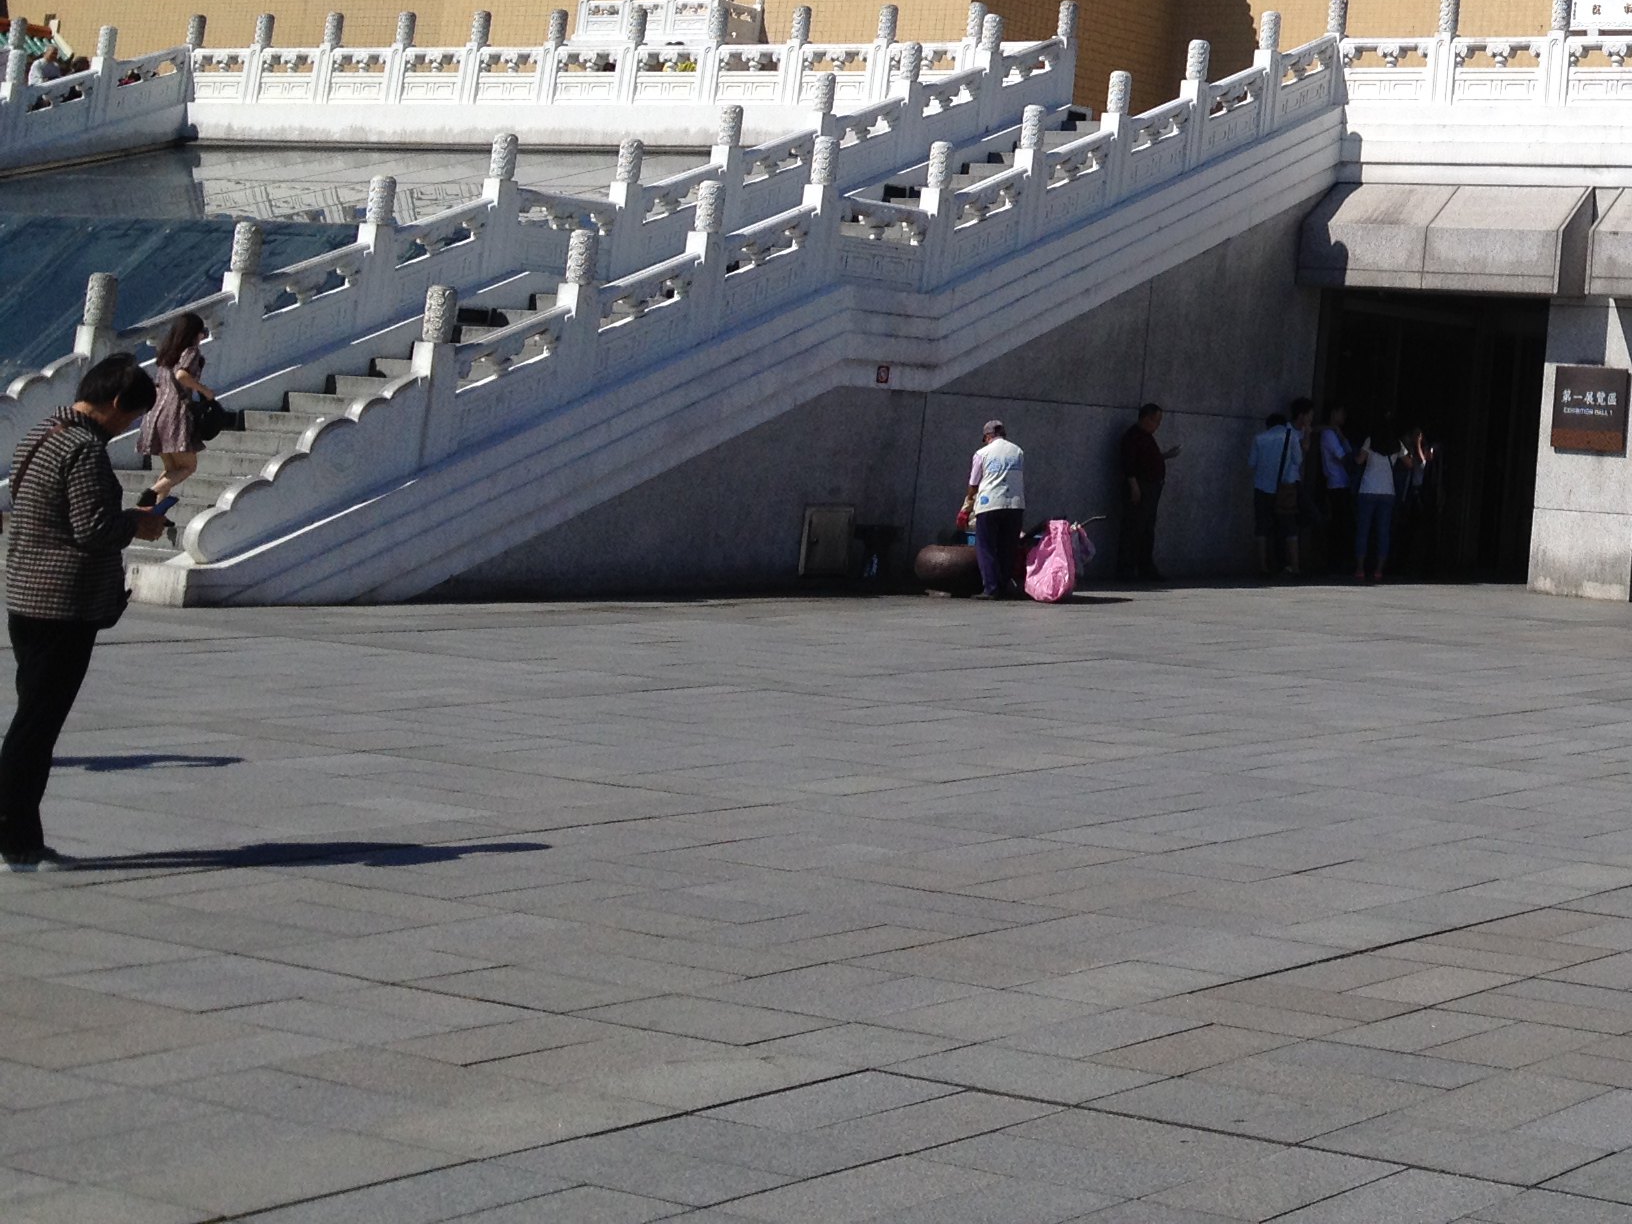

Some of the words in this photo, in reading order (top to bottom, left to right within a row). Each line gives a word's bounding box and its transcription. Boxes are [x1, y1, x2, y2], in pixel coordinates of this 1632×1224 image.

[1561, 389, 1617, 406] 第一展覽區
[1563, 407, 1593, 415] EXHIBITION
